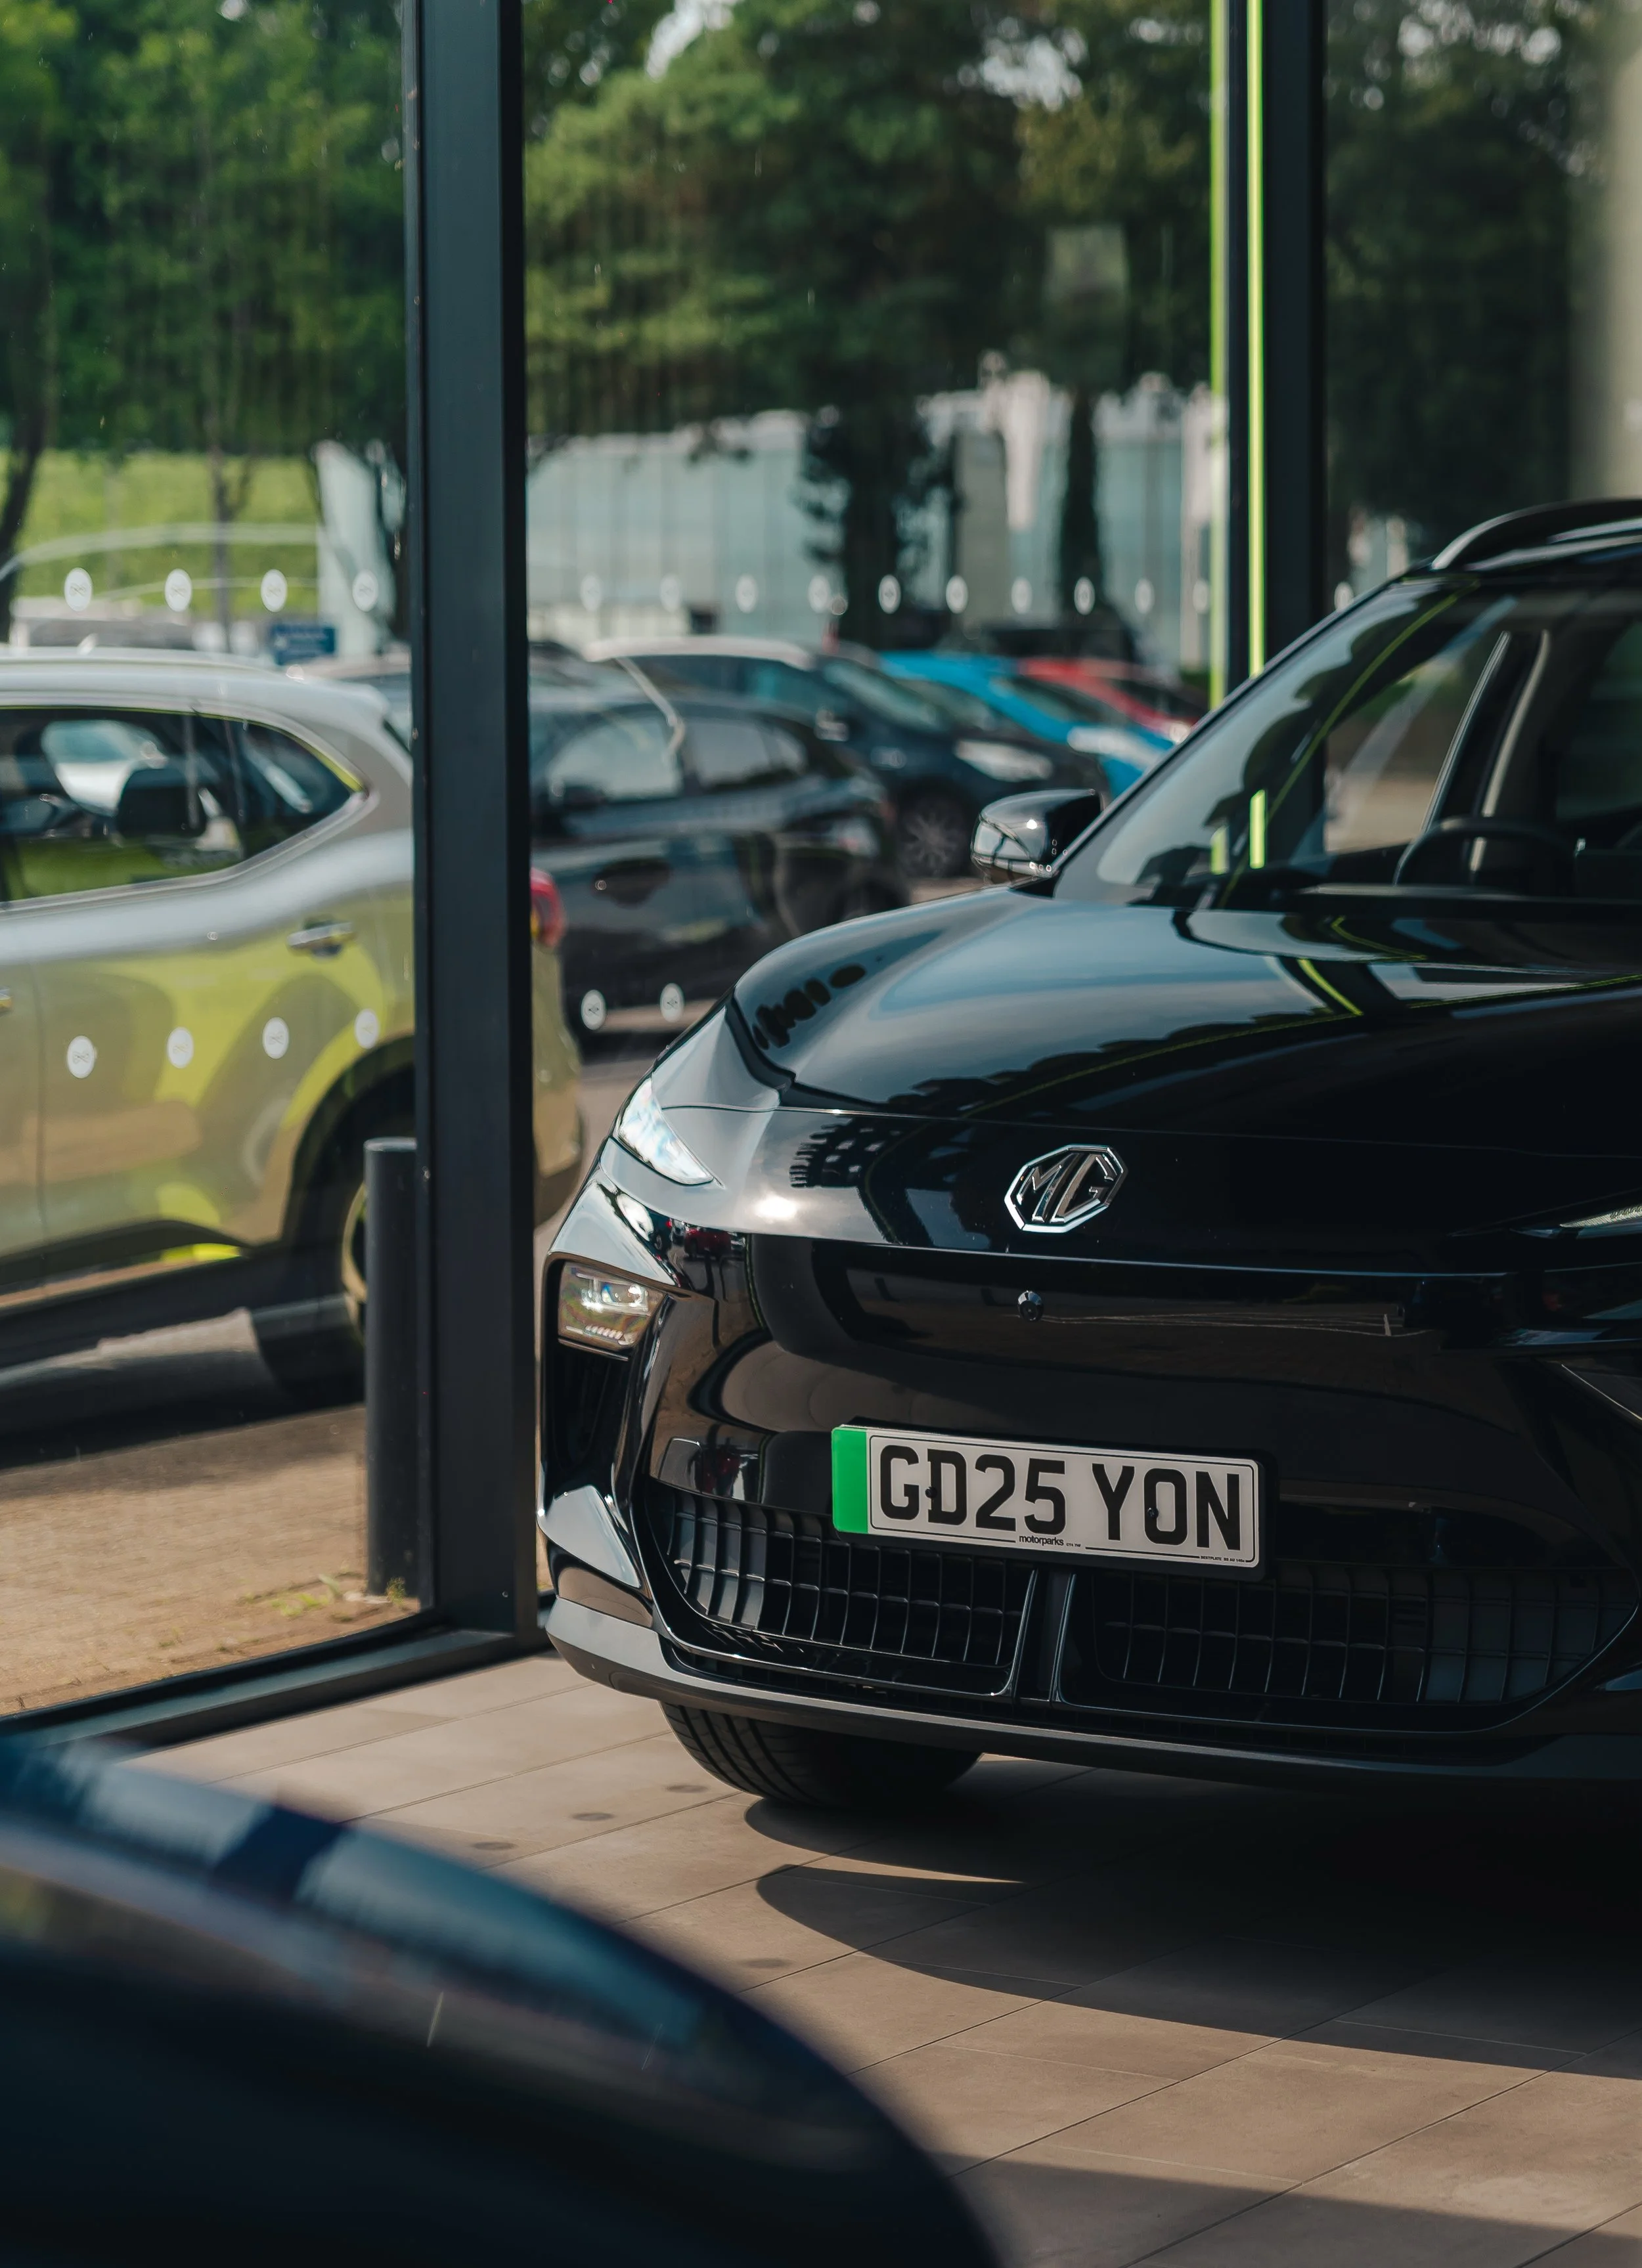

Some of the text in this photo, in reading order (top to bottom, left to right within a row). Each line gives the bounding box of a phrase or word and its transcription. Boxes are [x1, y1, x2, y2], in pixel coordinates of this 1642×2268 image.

[1017, 1152, 1118, 1223] MG
[879, 1444, 1241, 1551] GD25 YON
[1019, 1535, 1064, 1546] motorparks
